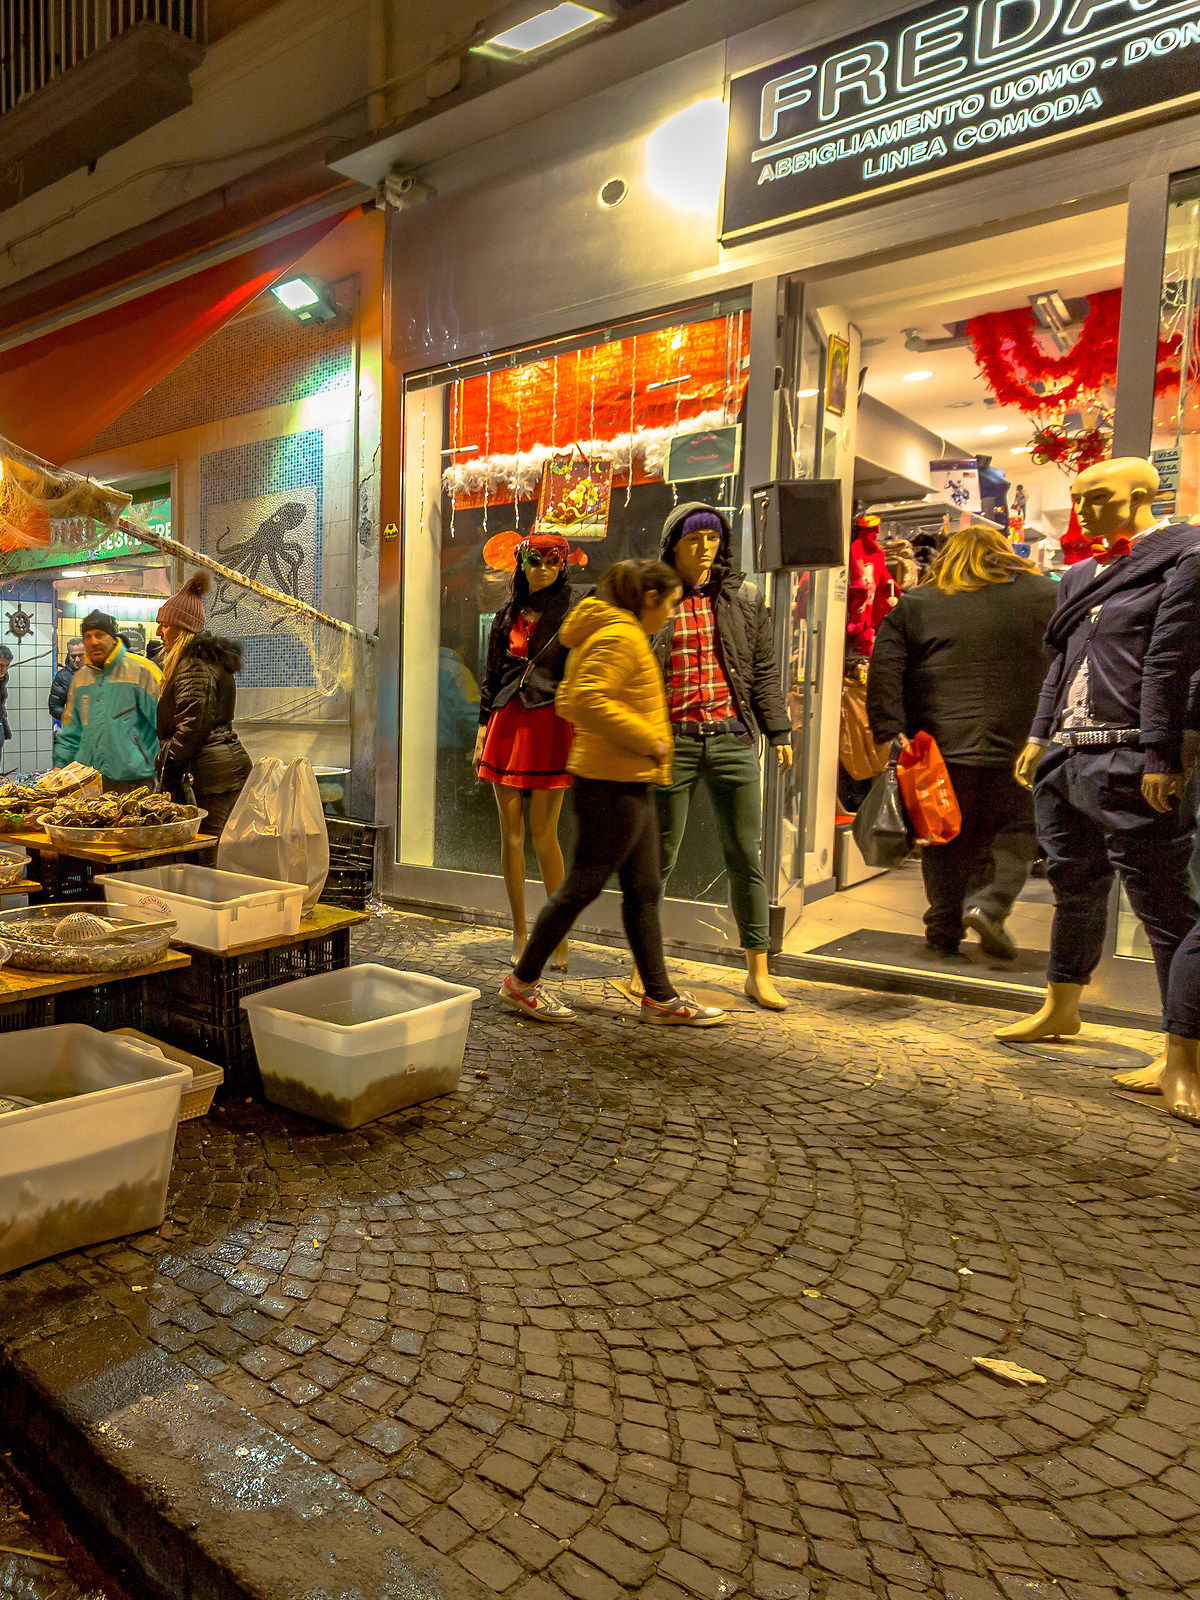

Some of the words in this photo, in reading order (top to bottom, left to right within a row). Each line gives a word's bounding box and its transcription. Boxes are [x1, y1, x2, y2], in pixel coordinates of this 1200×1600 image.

[757, 94, 985, 185] ABBIGLIAMENTO
[990, 56, 1096, 110] UOMO
[863, 136, 947, 179] LINEA
[953, 86, 1103, 150] COMODA
[1157, 450, 1178, 459] VISA
